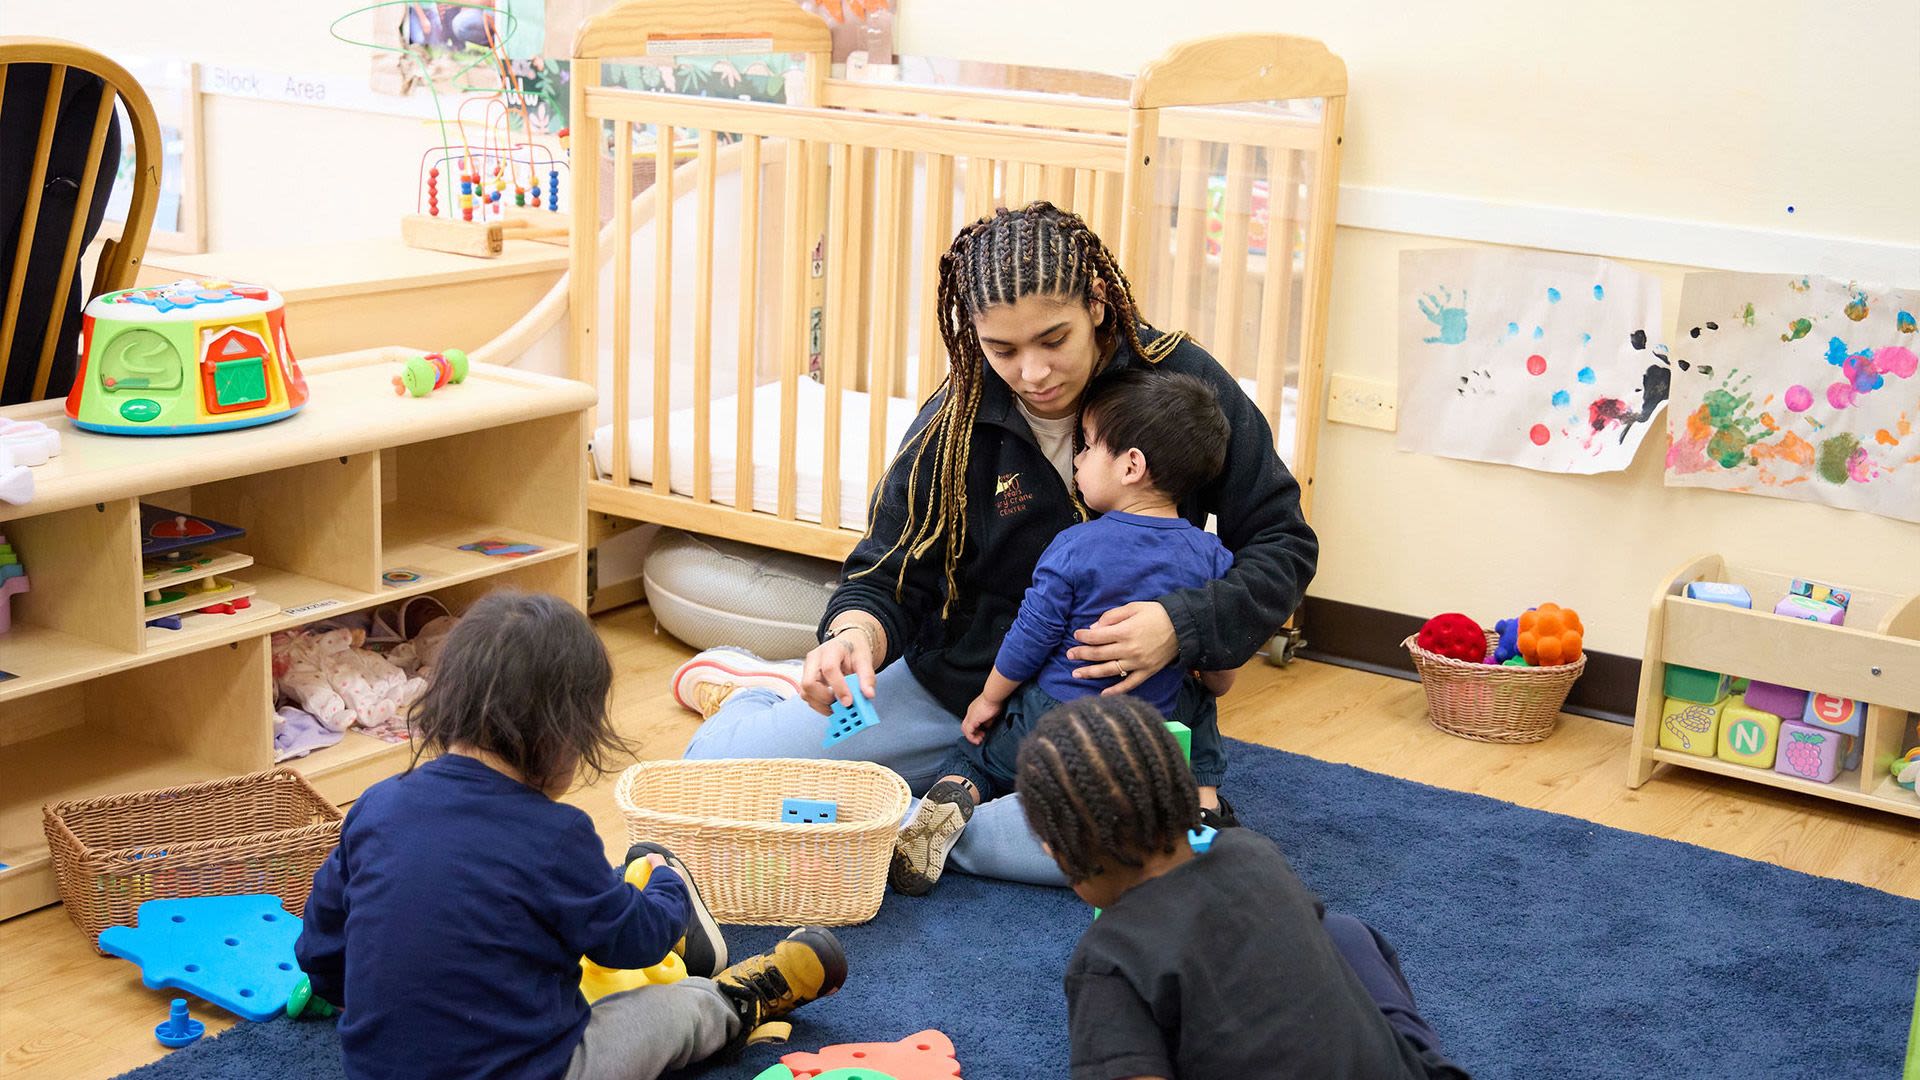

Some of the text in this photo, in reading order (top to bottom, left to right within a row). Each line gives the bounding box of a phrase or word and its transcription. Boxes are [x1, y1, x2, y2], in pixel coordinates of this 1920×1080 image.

[214, 67, 326, 100] Block Area
[1736, 724, 1759, 752] N
